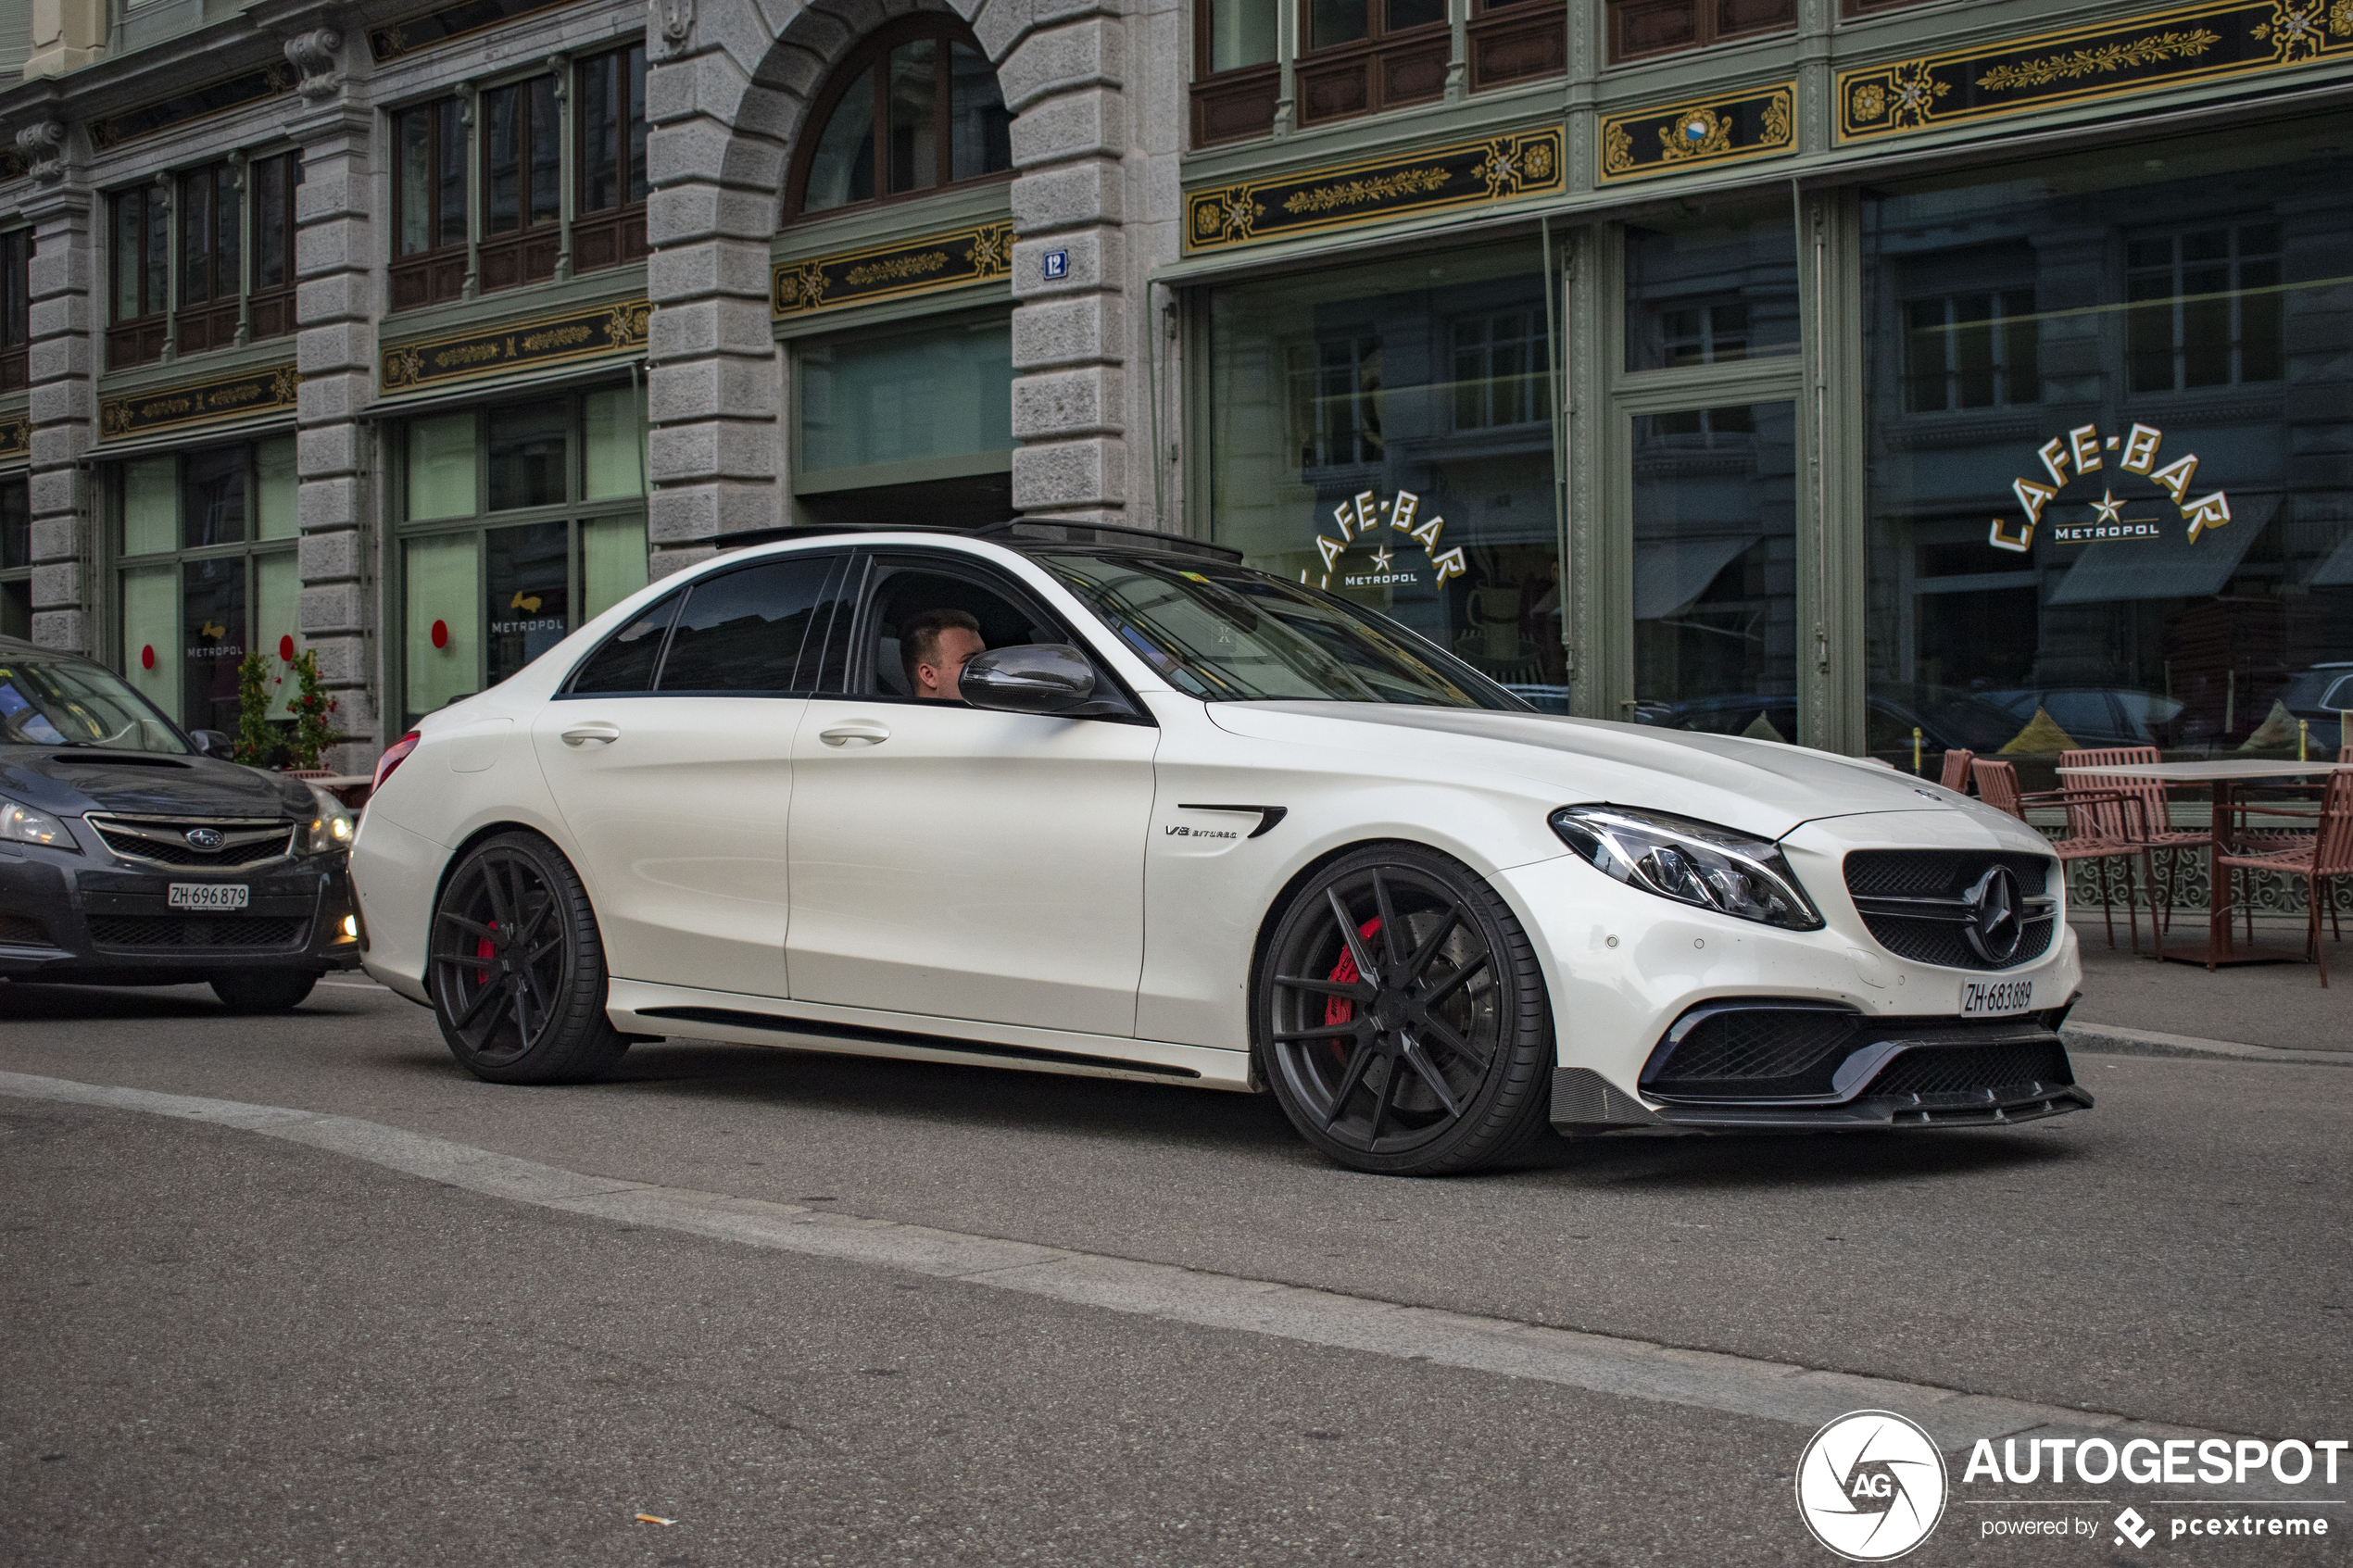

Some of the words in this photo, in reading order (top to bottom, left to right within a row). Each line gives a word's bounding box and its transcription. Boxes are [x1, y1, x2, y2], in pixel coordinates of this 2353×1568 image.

[1048, 255, 1061, 275] 12
[2055, 524, 2159, 540] METROPOL
[1345, 573, 1417, 586] METROPOL
[492, 619, 564, 633] METROPOL
[187, 646, 243, 658] METROPOL
[1165, 825, 1190, 836] V8
